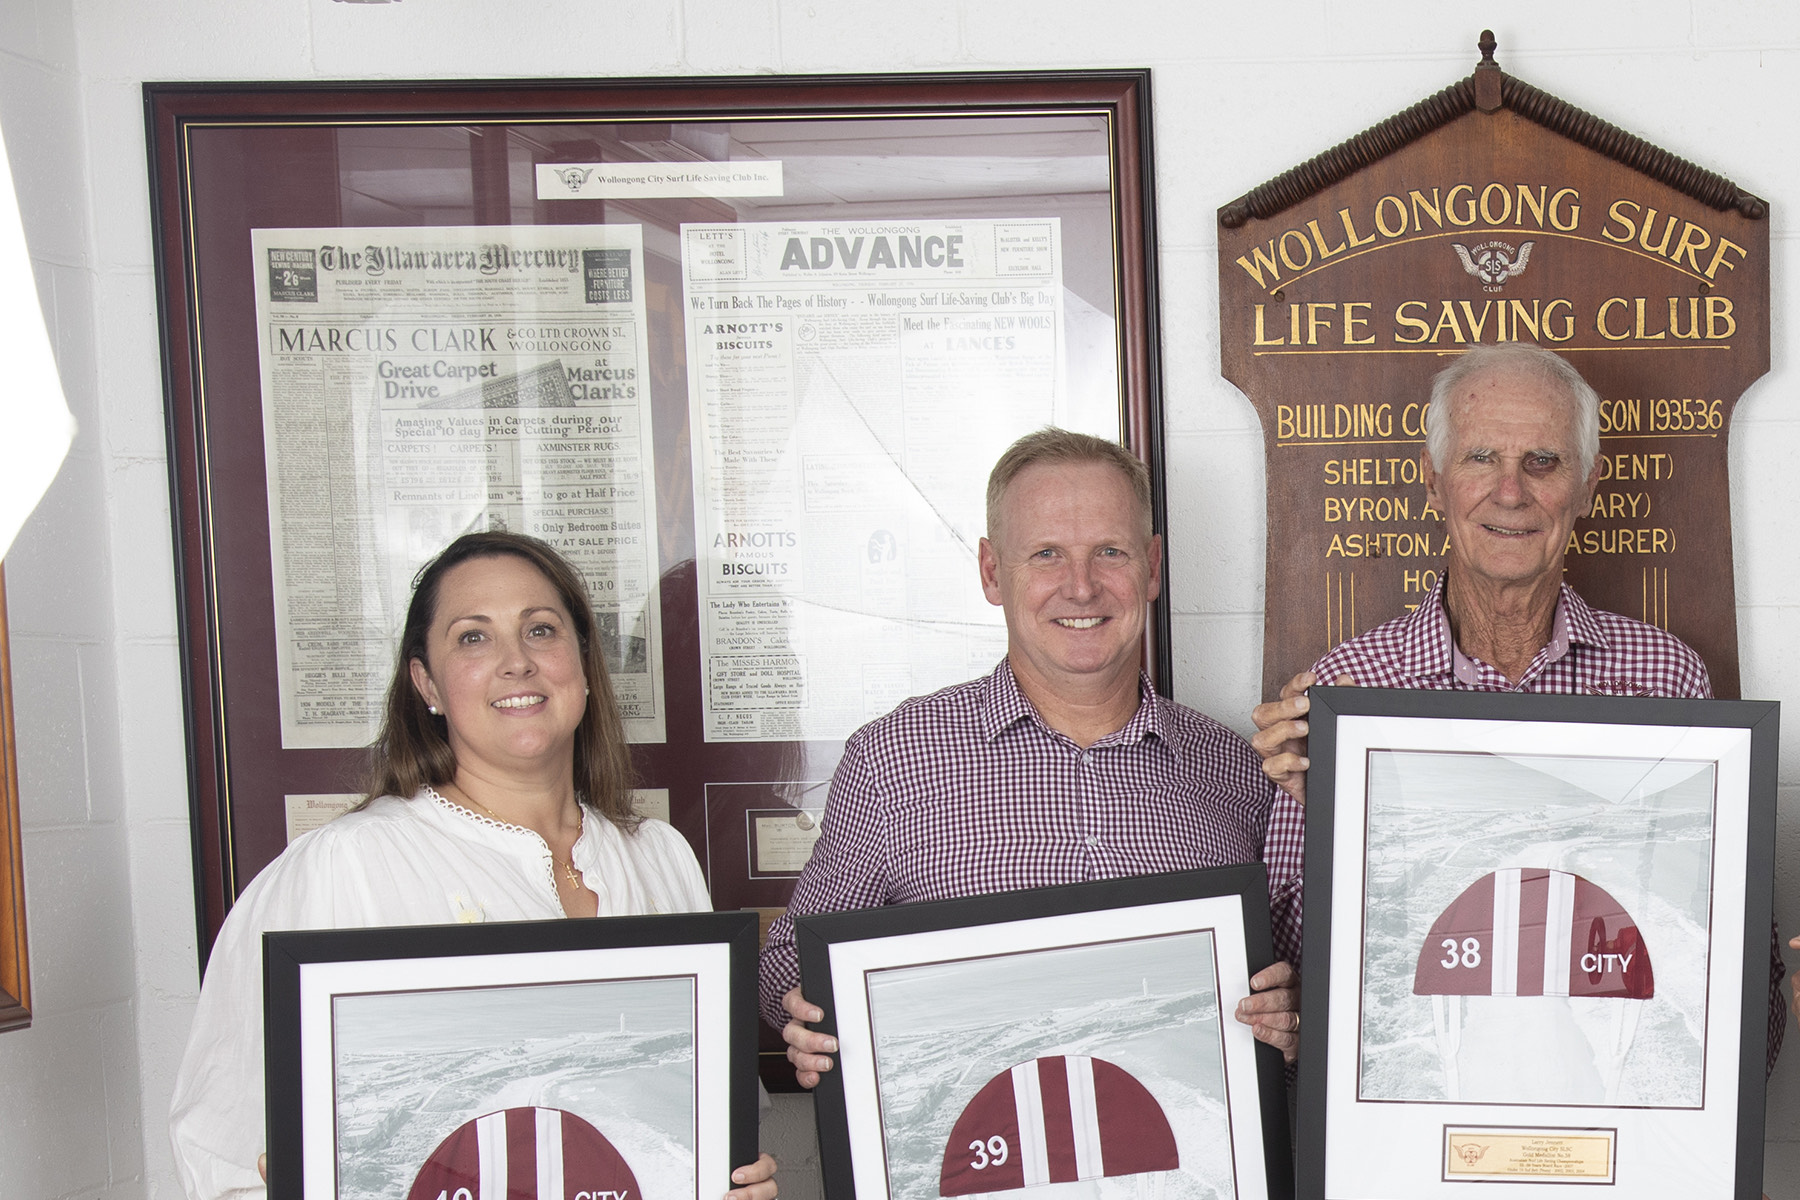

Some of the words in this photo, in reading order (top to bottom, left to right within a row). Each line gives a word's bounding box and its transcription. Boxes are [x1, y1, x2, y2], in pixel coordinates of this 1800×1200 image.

[598, 174, 646, 184] Wollongong
[647, 174, 664, 184] City
[667, 173, 685, 182] Surf
[686, 173, 702, 182] Life
[704, 173, 731, 183] Saving
[732, 172, 752, 181] Club
[754, 172, 769, 181] Inc.
[699, 232, 734, 240] LETT'S
[821, 227, 840, 235] THE
[848, 226, 920, 235] WOLLONGONG
[1236, 182, 1581, 289] WOLLONGONG
[1601, 199, 1748, 280] SURF
[780, 235, 964, 270] ADVANCE
[1471, 241, 1516, 255] WOLLONGONG
[320, 245, 362, 271] The
[479, 243, 580, 275] Mercury
[1485, 259, 1502, 274] SLS
[1483, 285, 1503, 293] CLUB
[690, 296, 705, 310] We
[707, 296, 729, 309] Turn
[731, 295, 753, 309] Back
[756, 294, 773, 308] The
[776, 294, 802, 310] Pages
[804, 294, 815, 308] of
[816, 294, 848, 309] History
[867, 292, 917, 308] Wollongong
[920, 292, 940, 305] Surf
[991, 291, 1017, 305] Club's
[1020, 291, 1034, 306] Big
[1038, 291, 1055, 306] Day
[703, 322, 784, 335] ARNOTT'S
[903, 317, 924, 331] Meet
[926, 317, 941, 330] the
[994, 316, 1015, 329] NEW
[1018, 315, 1051, 329] WOOLS
[1253, 302, 1376, 346] LIFE
[1394, 299, 1575, 344] SAVING
[1595, 296, 1737, 341] CLUB
[279, 327, 397, 352] MARCUS
[412, 327, 497, 352] CLARK
[564, 327, 610, 339] CROWN
[509, 340, 612, 351] WOLLONGONG
[716, 340, 773, 351] BISCUITS
[595, 358, 608, 367] at
[378, 360, 431, 379] Great
[433, 359, 498, 382] Carpet
[568, 367, 636, 382] Marcus
[385, 380, 440, 399] Drive
[570, 382, 636, 401] Clark's
[395, 417, 442, 431] Amazing
[448, 417, 484, 428] Values
[489, 415, 500, 425] in
[504, 415, 546, 426] Carpets
[552, 414, 595, 426] during
[599, 415, 623, 424] our
[1277, 402, 1393, 439] BUILDING
[395, 427, 436, 439] Special
[459, 427, 481, 438] day
[488, 425, 518, 435] Price
[525, 424, 572, 438] Cutting
[1324, 457, 1426, 486] SHELTO
[393, 490, 442, 501] Remnants
[543, 490, 553, 499] to
[556, 492, 568, 501] go
[571, 490, 581, 499] at
[585, 488, 607, 499] Half
[610, 487, 636, 498] Price
[533, 508, 565, 517] SPECIAL
[542, 523, 564, 534] Only
[567, 521, 609, 532] Bedroom
[611, 520, 642, 531] Suites
[563, 538, 576, 547] AT
[578, 538, 604, 547] SALE
[607, 536, 638, 545] PRICE
[713, 530, 797, 548] ARNOTT'S
[1564, 528, 1677, 555] ASURER)
[735, 551, 774, 559] FAMOUS
[722, 562, 788, 576] BISCUITS
[715, 636, 762, 645] BRANDON'S
[716, 659, 729, 667] The
[732, 659, 761, 667] MISSES
[763, 657, 800, 666] HARMON
[1440, 936, 1482, 970] 38
[1580, 953, 1633, 973] CITY
[968, 1135, 1009, 1170] 39
